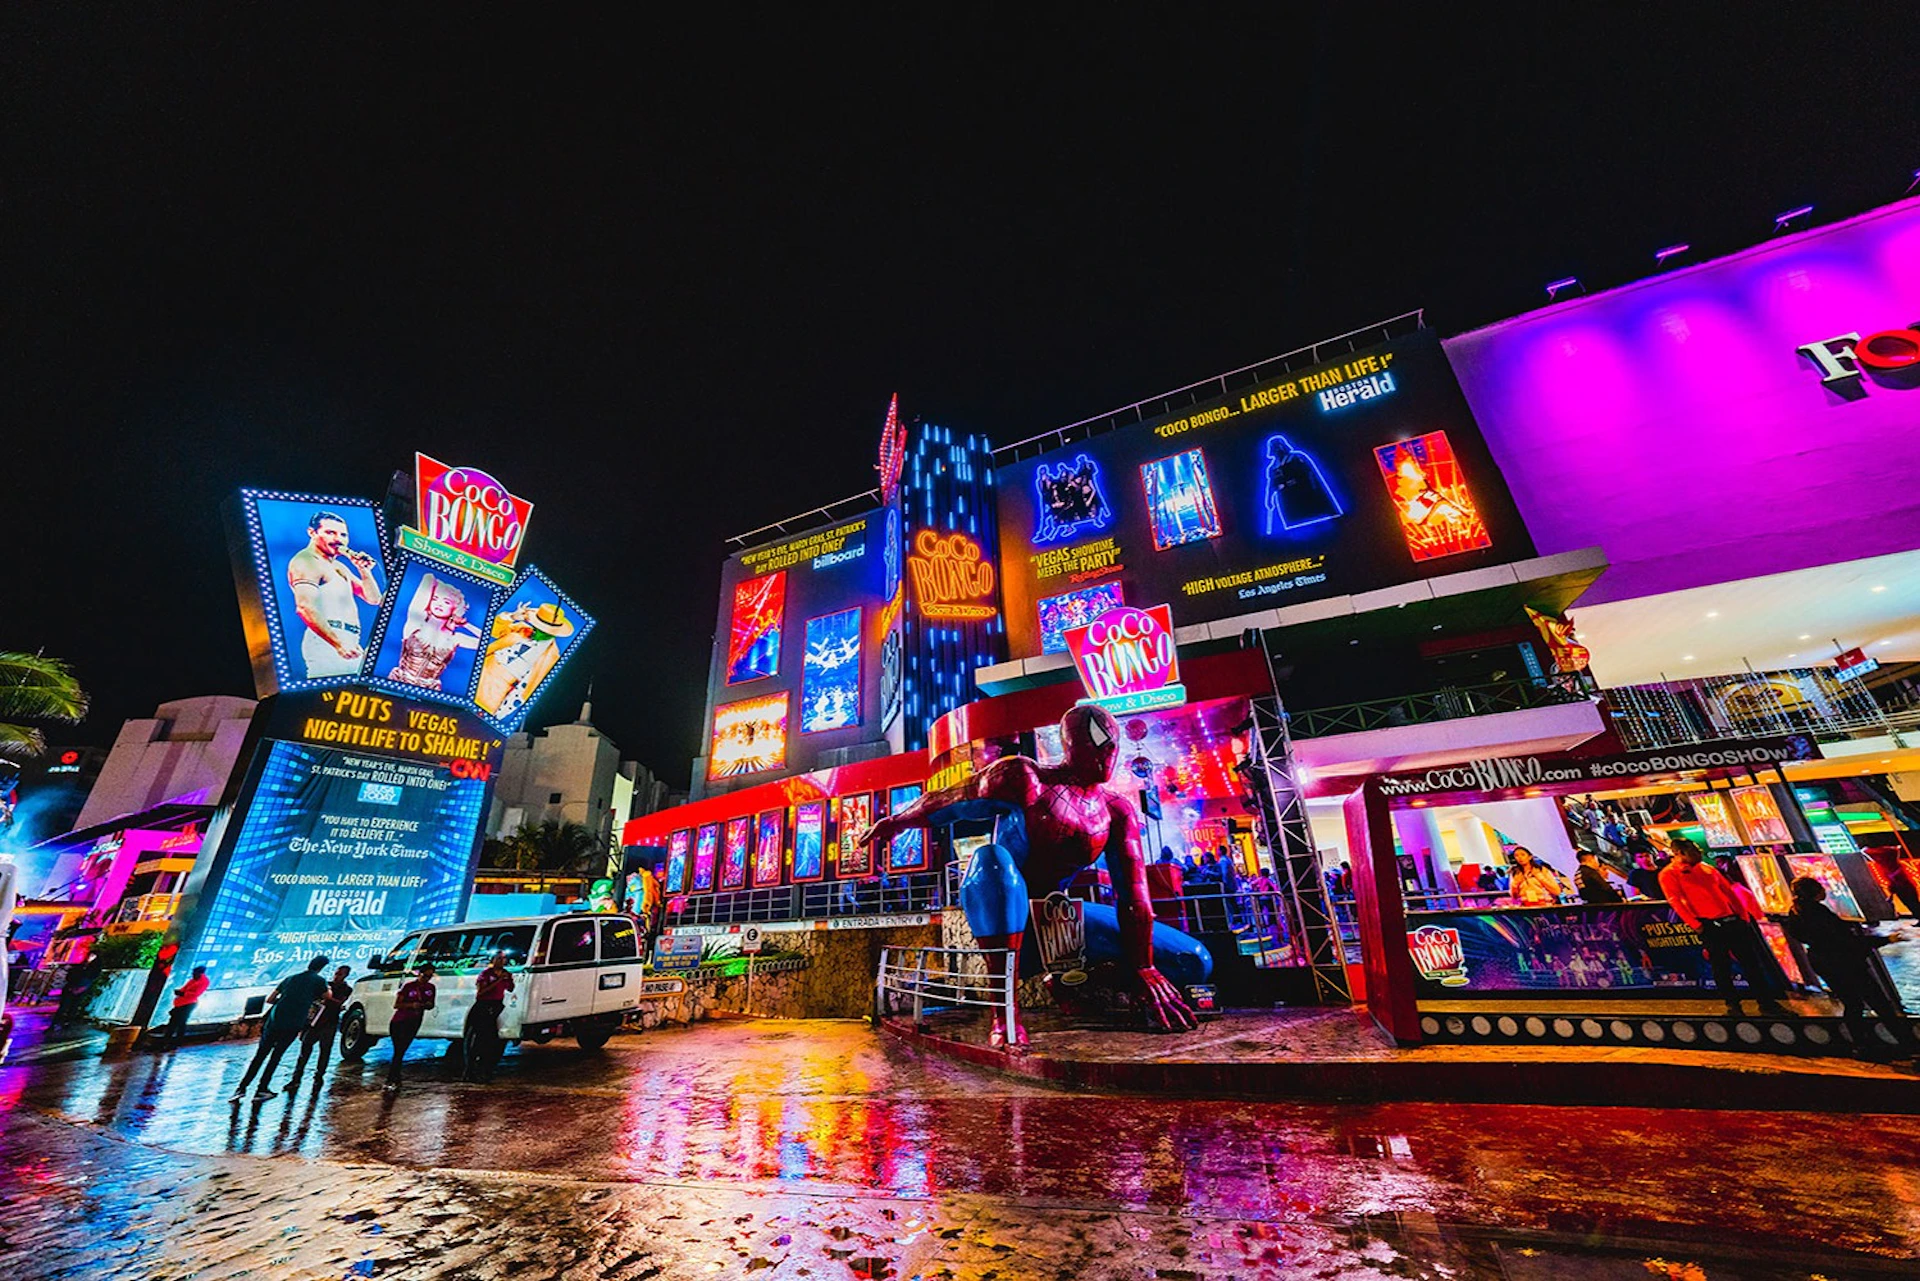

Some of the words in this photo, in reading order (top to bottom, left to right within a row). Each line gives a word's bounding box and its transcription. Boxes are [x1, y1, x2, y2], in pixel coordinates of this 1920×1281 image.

[1798, 331, 1920, 381] FO
[1318, 371, 1396, 411] Herald
[1333, 379, 1370, 394] BOSTON
[1154, 418, 1189, 438] "COCO
[1240, 381, 1299, 413] LARGER
[1299, 367, 1344, 394] THAN
[427, 489, 521, 551] BONGO
[412, 537, 452, 560] Show
[455, 553, 467, 566] &
[471, 559, 506, 580] Disco
[767, 551, 799, 570] ROLLED
[799, 545, 820, 560] INTO
[812, 543, 866, 570] billboard
[1030, 547, 1071, 568] "VEGAS
[1070, 537, 1115, 560] SHOWTIME
[908, 554, 994, 604] BONGO
[1036, 564, 1063, 580] MEETS
[1063, 559, 1080, 573] THE
[1215, 571, 1253, 589] VOLTAGE
[1238, 588, 1256, 599] Los
[1256, 580, 1294, 596] Angeles
[1295, 572, 1327, 587] Times
[1081, 632, 1173, 698] BONGO
[322, 691, 393, 722] "PUTS
[408, 710, 458, 735] VEGAS
[1126, 697, 1136, 707] &
[1140, 693, 1177, 705] Disco
[303, 718, 397, 749] NIGHTLIFE
[400, 732, 420, 752] TO
[322, 766, 356, 779] PATRICK'S
[371, 770, 405, 786] ROLLED
[405, 776, 427, 788] INTO
[450, 759, 492, 782] CNN
[330, 827, 338, 837] IT
[339, 828, 350, 838] TO
[350, 828, 384, 841] BELIEVE
[341, 816, 359, 826] HAVE
[359, 818, 370, 827] TO
[370, 817, 420, 833] EXPERIENCE
[289, 836, 321, 853] The
[320, 839, 354, 855] New
[353, 841, 390, 860] York
[389, 843, 429, 859] Times
[336, 874, 374, 887] LARGER
[376, 874, 399, 887] THAN
[305, 889, 388, 917] Herald
[842, 918, 880, 927] ENTRADA
[886, 916, 913, 925] ENTRY
[1041, 920, 1084, 965] BONGO
[1646, 935, 1690, 948] NIGHTLIFE
[251, 947, 284, 965] Los
[1414, 943, 1461, 972] BONGO
